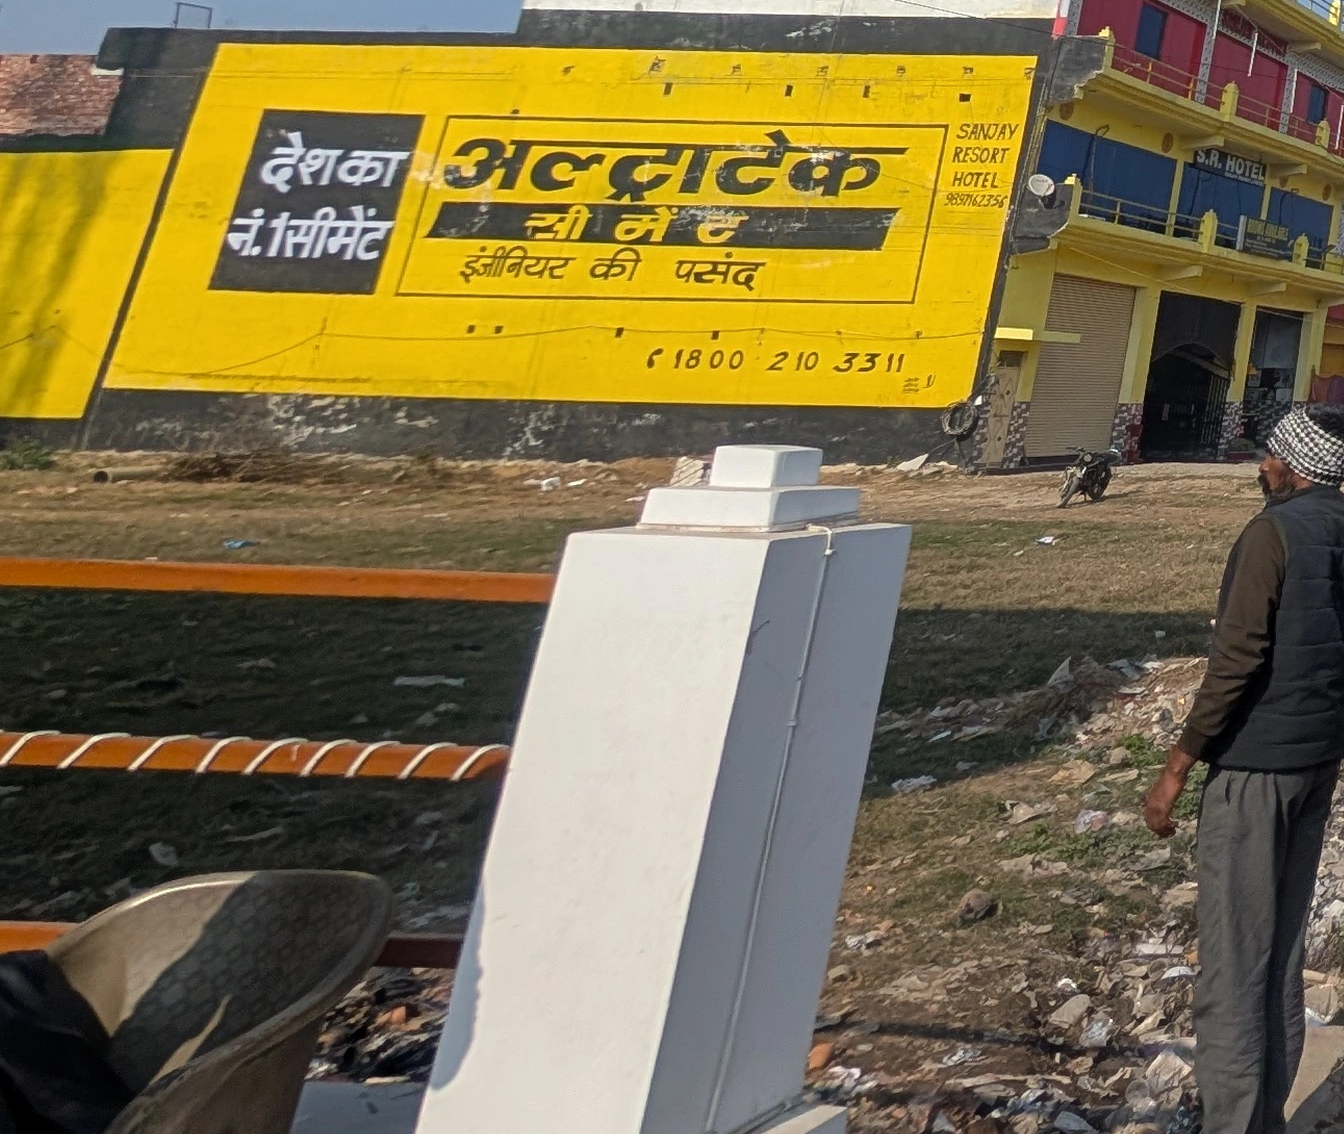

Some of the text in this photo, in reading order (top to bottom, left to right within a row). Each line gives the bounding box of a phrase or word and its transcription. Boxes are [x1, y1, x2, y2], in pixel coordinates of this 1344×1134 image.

[956, 123, 1020, 141] SANJAY
[261, 131, 412, 194] देश का
[442, 128, 909, 202] अल्ट्राटेक
[952, 146, 1011, 163] RESORT
[1196, 148, 1222, 169] S.R.
[1225, 154, 1266, 181] HOTEL
[951, 171, 999, 188] HOTEL
[284, 205, 395, 260] सीमेंट
[459, 245, 766, 292] इंजीनियर की पसंद
[673, 347, 905, 374] 1800 210 3311
